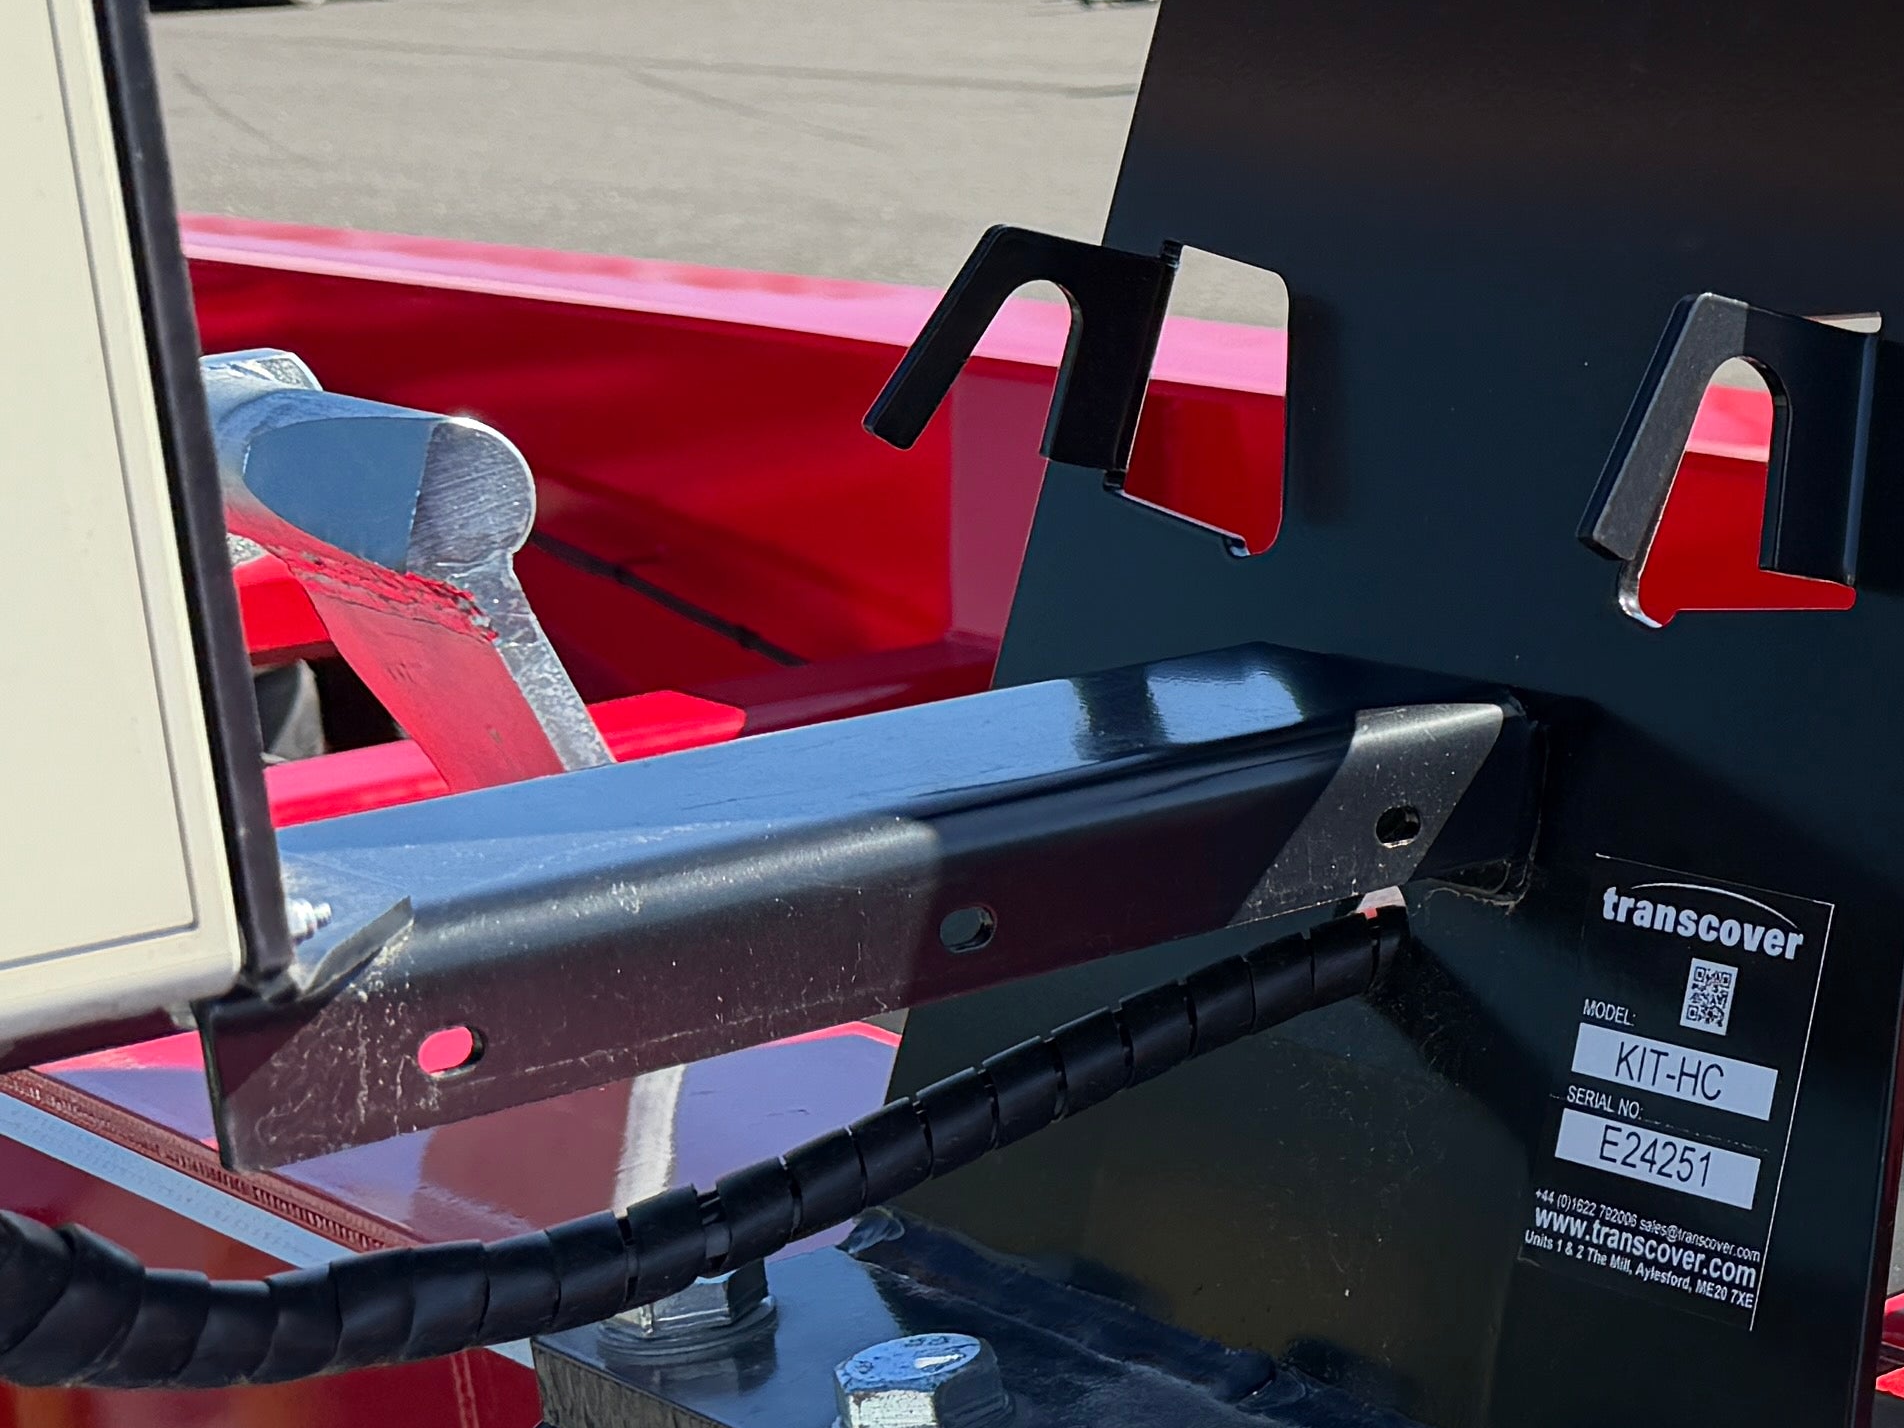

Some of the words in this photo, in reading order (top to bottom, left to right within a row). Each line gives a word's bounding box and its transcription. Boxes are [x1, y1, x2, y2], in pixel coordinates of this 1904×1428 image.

[1601, 885, 1804, 961] transcover
[1582, 997, 1638, 1027] MODEL:
[1566, 1084, 1616, 1114] SERIAL
[1614, 1040, 1725, 1102] KIT-HC
[1598, 1123, 1712, 1188] E24251
[1534, 1206, 1758, 1289] www.transcover.com
[1535, 1188, 1555, 1204] +44
[1556, 1193, 1598, 1219] (0)1622
[1638, 1217, 1762, 1264] sales@transcover.com
[1524, 1229, 1554, 1251] Units
[1556, 1238, 1563, 1253] 1
[1564, 1240, 1574, 1256] &
[1575, 1243, 1584, 1260] 2
[1586, 1247, 1608, 1267] The
[1609, 1253, 1633, 1276] Mill,
[1635, 1261, 1693, 1294] Aylesford,
[1695, 1278, 1728, 1302] ME20
[1730, 1288, 1755, 1310] 7XE
